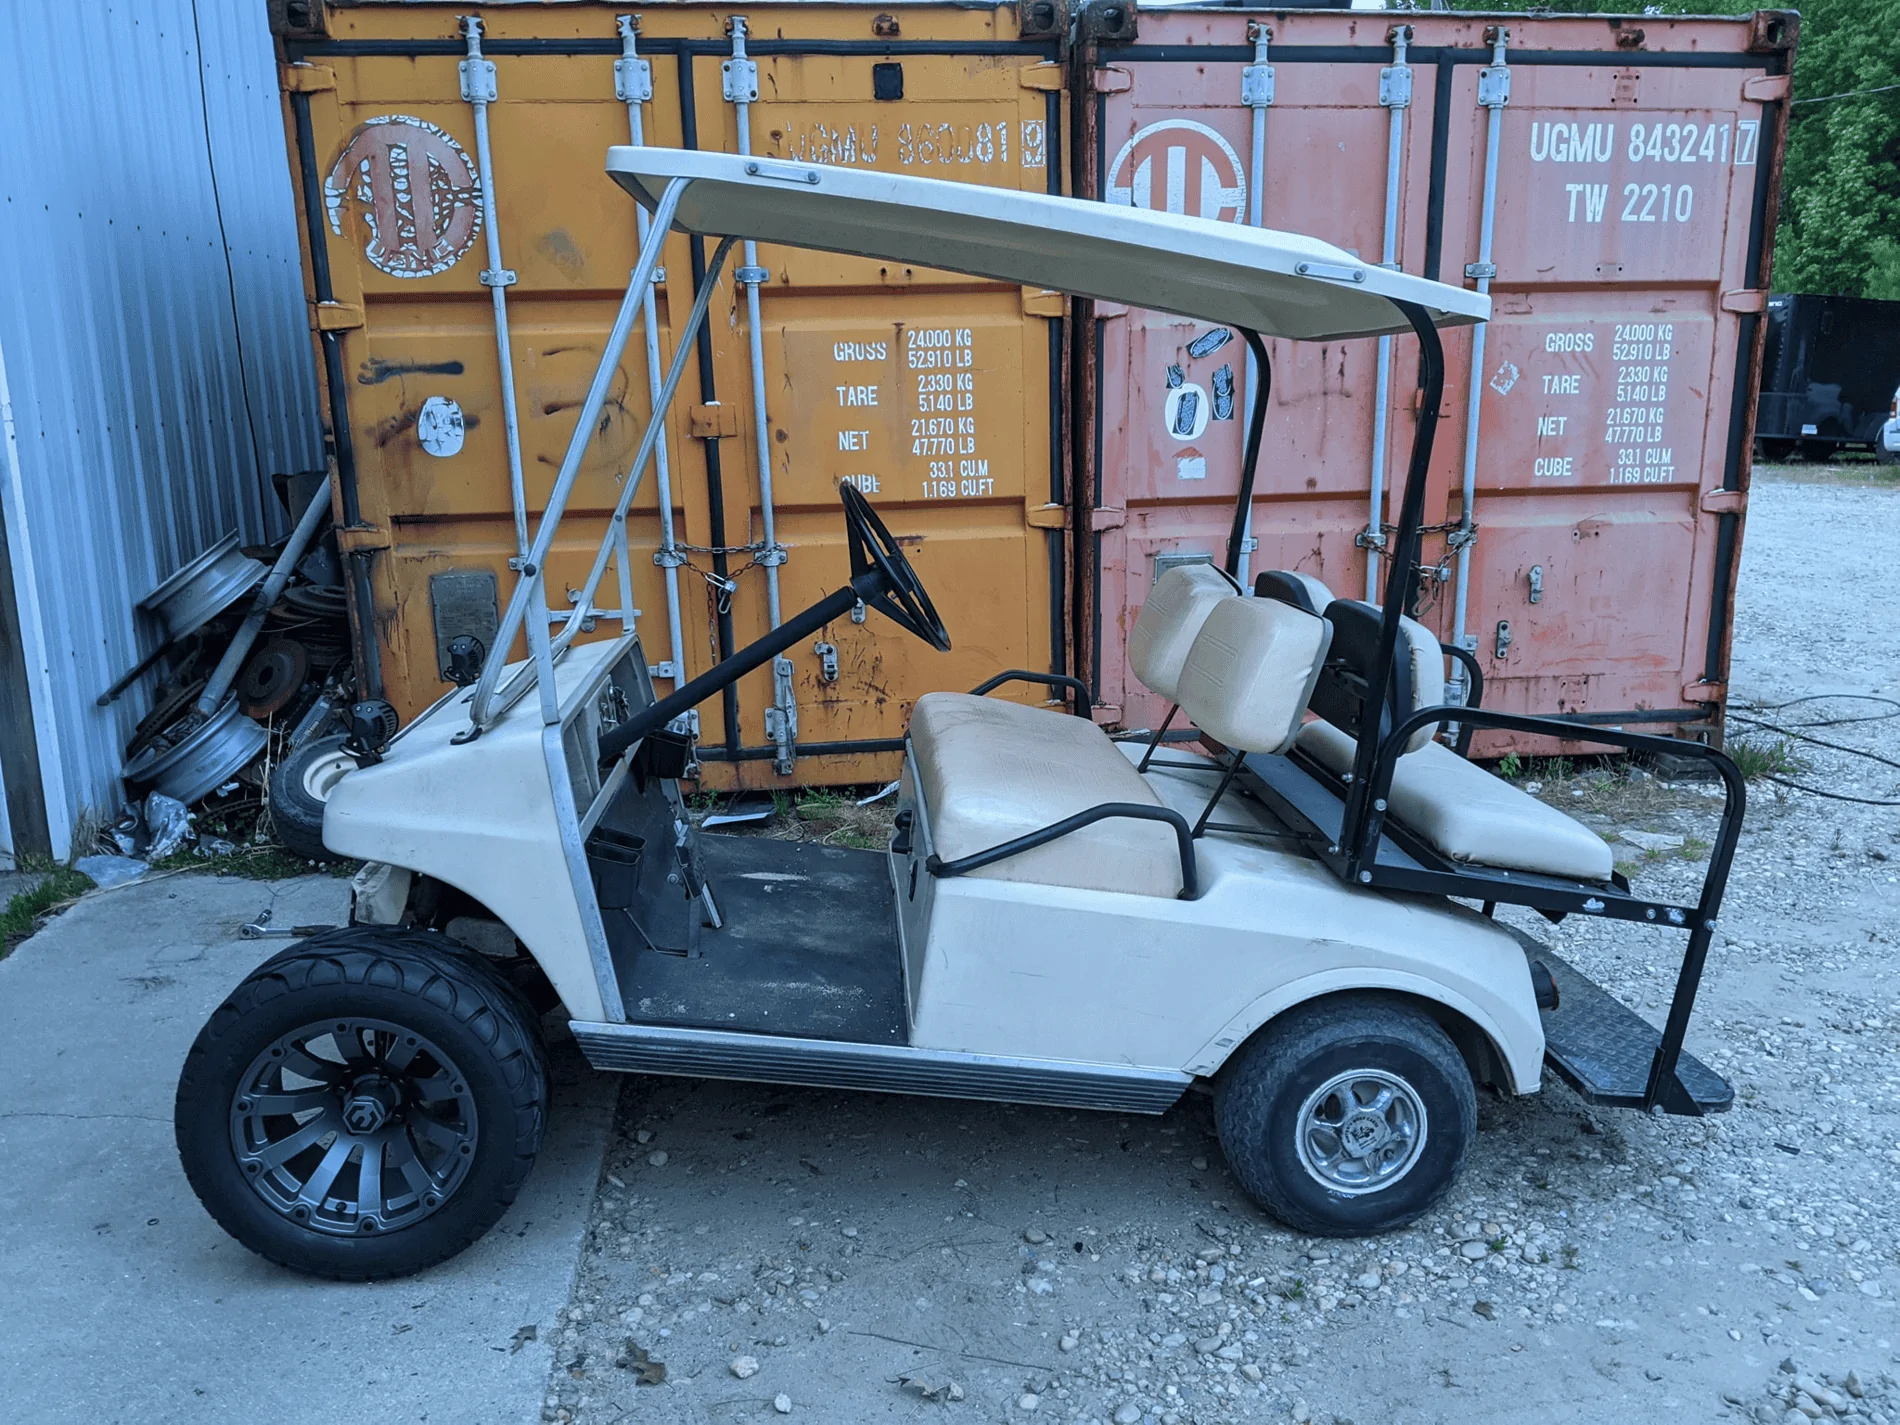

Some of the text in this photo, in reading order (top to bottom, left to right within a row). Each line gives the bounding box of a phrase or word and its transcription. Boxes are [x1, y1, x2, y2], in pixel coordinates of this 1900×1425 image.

[1530, 122, 1614, 162] UGMU
[1565, 183, 1693, 222] TW 2210
[907, 328, 972, 348] 24.000 KG
[1614, 324, 1673, 341] 24.000 KG
[1545, 333, 1594, 352] GROSS
[1612, 343, 1671, 361] 52.910 LB
[908, 349, 973, 368] 52.910 LB
[917, 373, 973, 392] 2.330 KG
[1652, 366, 1668, 382] KG
[1542, 375, 1581, 394] TARE
[1616, 386, 1666, 402] 5.140 LB
[836, 385, 878, 407] TARE
[918, 394, 973, 412] 5.140 LB
[1606, 407, 1664, 425] 21.670 KG
[911, 417, 975, 436] 21.670 KG
[1536, 416, 1568, 436] NET
[1605, 427, 1662, 443] 47.770 LB
[838, 431, 869, 451] NET
[912, 437, 975, 456] 47.770 LB
[1617, 449, 1641, 465] 33.1
[929, 459, 988, 478] 33.1 CU.M
[1534, 457, 1573, 477] CUBE
[1609, 466, 1675, 484] 1.169 CU.FT
[922, 479, 993, 498] 1.169 CU.FT
